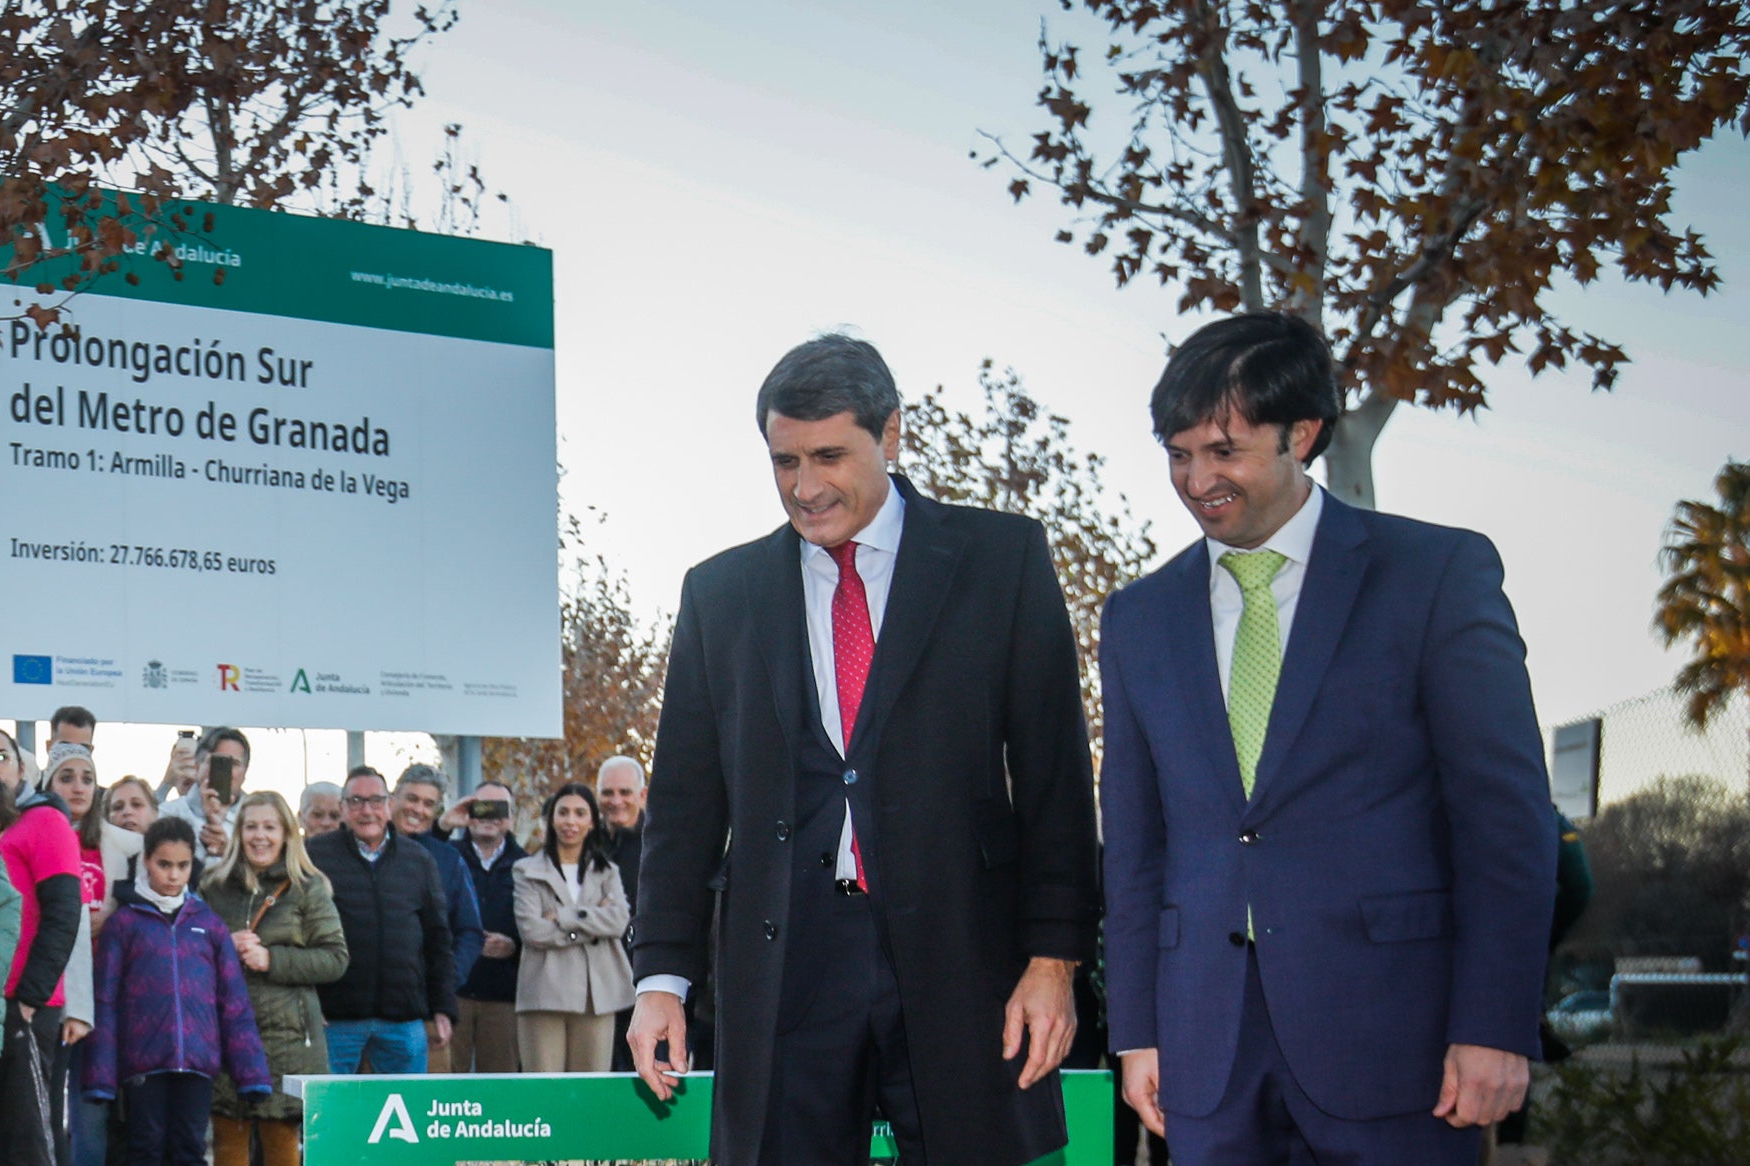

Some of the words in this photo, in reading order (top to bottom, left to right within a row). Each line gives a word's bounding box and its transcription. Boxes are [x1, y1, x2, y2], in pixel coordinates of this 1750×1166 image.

[150, 241, 241, 267] Adalucía
[10, 320, 245, 383] Prolongación
[258, 347, 313, 388] Sur
[10, 383, 64, 425] del
[78, 390, 184, 437] Metro
[196, 401, 236, 441] de
[248, 407, 390, 457] Granada
[9, 442, 79, 470] Tramo
[87, 449, 104, 472] 1:
[110, 451, 185, 479] Armilla
[205, 459, 305, 489] Churriana
[311, 468, 335, 492] de
[341, 470, 357, 494] la
[363, 474, 410, 504] Vega
[11, 538, 105, 563] Inversión:
[110, 545, 222, 572] 27.766.678,65
[227, 556, 276, 575] euros
[427, 1100, 482, 1116] Junta
[427, 1120, 450, 1138] de
[455, 1117, 551, 1138] Andalucía
